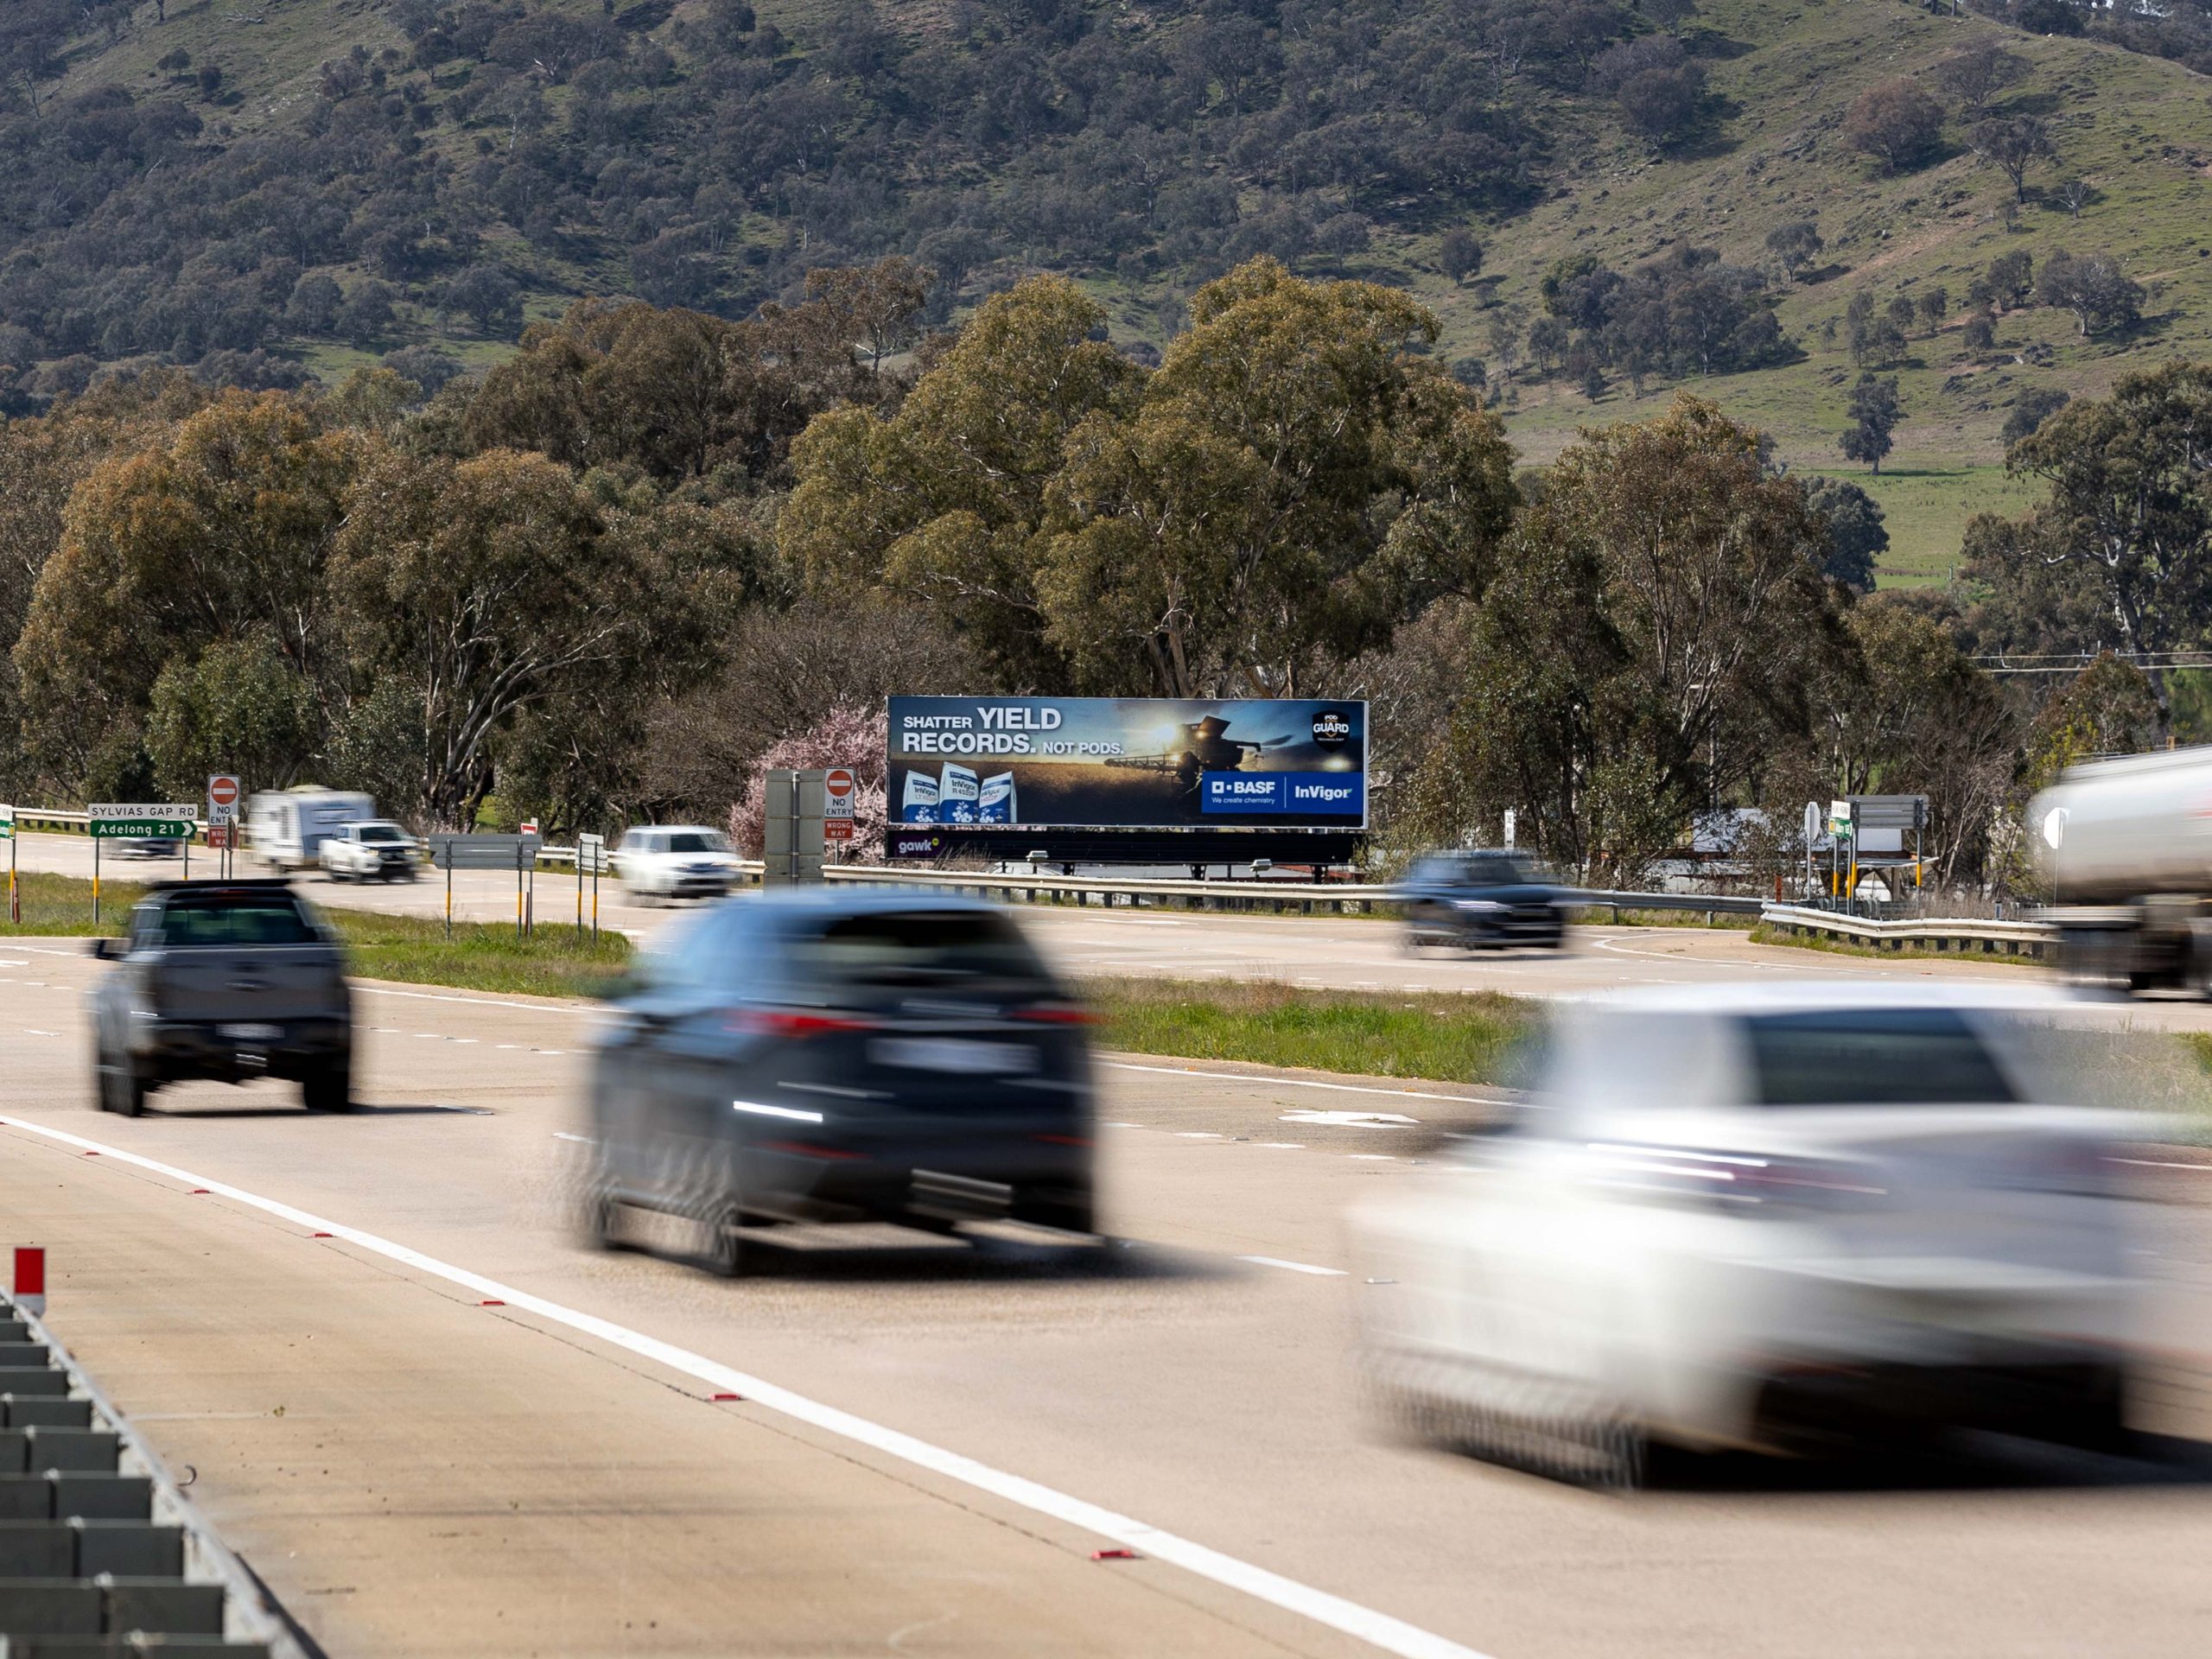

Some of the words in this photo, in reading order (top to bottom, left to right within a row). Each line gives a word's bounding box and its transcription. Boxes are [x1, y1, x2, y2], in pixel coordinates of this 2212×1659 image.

[904, 716, 972, 728] SHATTER
[977, 707, 1061, 729] YIELD
[1313, 722, 1349, 733] GUARD
[903, 733, 1037, 753] RECORDS.
[1043, 742, 1075, 754] NOT
[1078, 742, 1125, 755] PODS.
[1234, 781, 1275, 794] BASF
[1295, 785, 1351, 801] InVigor
[1244, 797, 1275, 805] chemistry
[92, 807, 143, 817] SYLVIAS
[149, 807, 173, 817] GAP
[180, 807, 194, 817] RD
[99, 823, 152, 836] Adelong
[159, 824, 175, 835] 21
[899, 839, 932, 854] gawk
